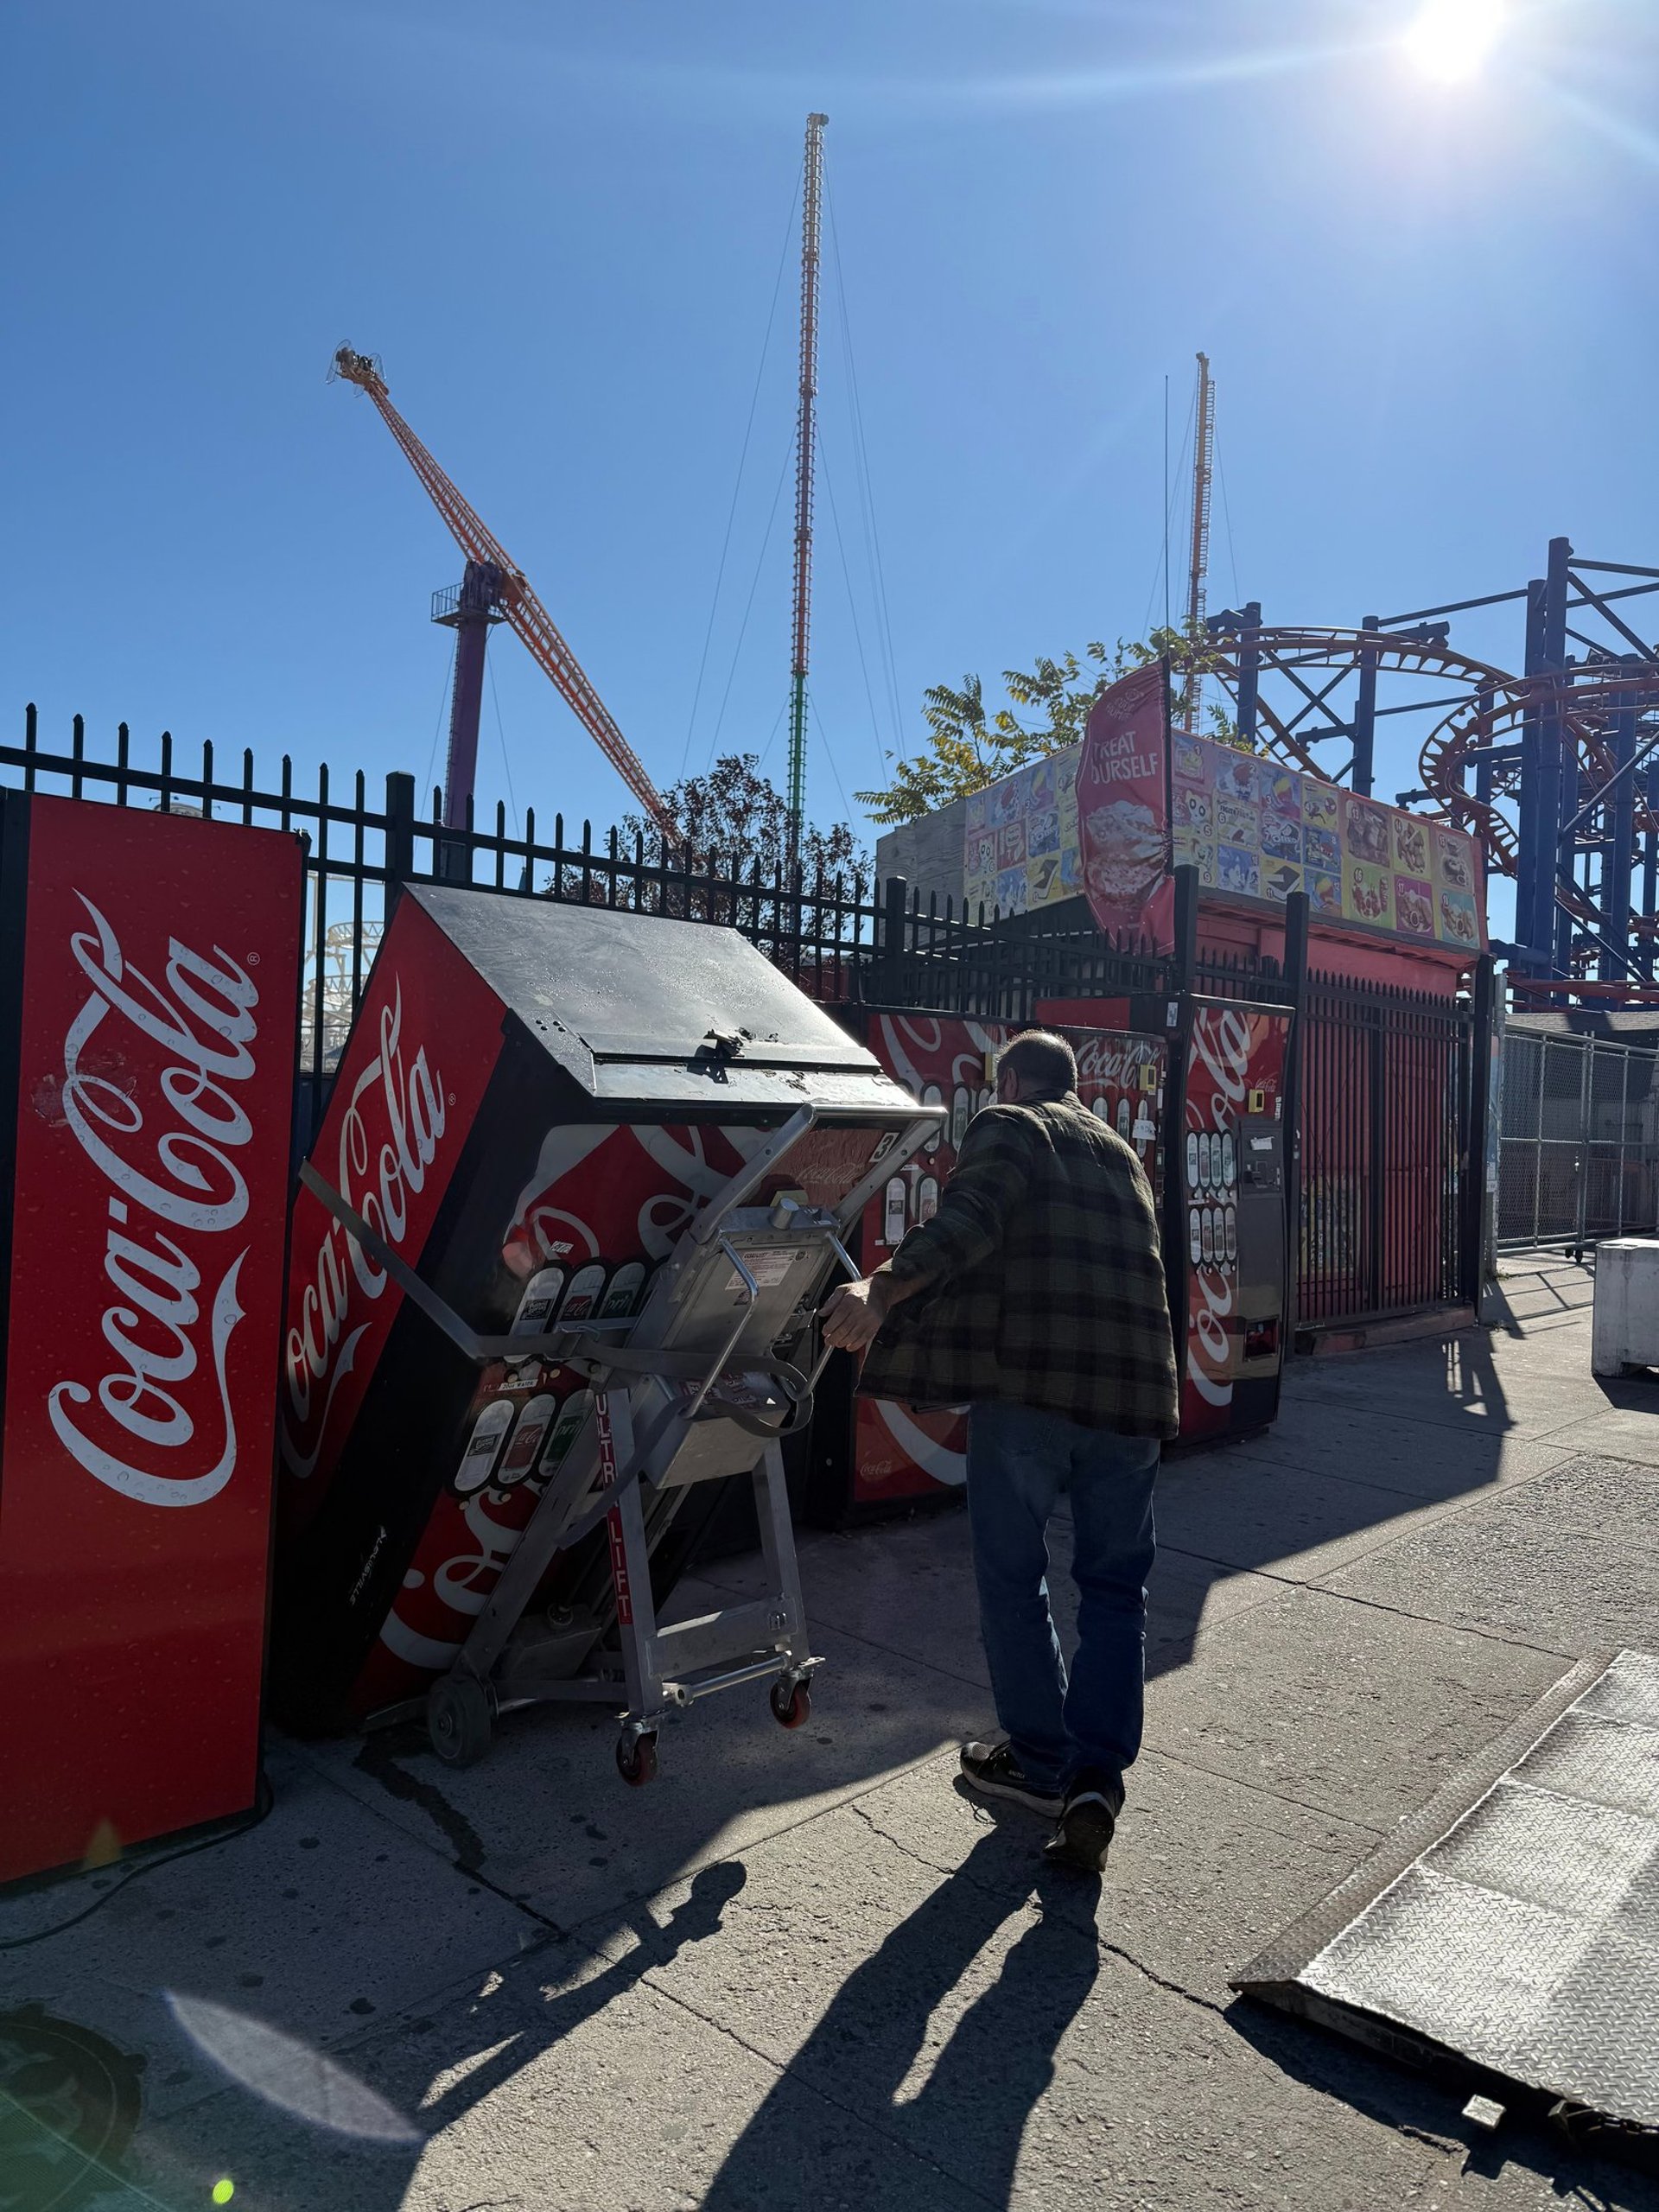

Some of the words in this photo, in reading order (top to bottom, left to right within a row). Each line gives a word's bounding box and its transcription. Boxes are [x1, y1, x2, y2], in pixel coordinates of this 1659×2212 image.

[1092, 731, 1136, 760] TREAT
[874, 1135, 894, 1160] 3
[48, 887, 261, 1508] Coca-Cola
[595, 1394, 619, 1507] ULTR
[610, 1520, 633, 1618] LIFT
